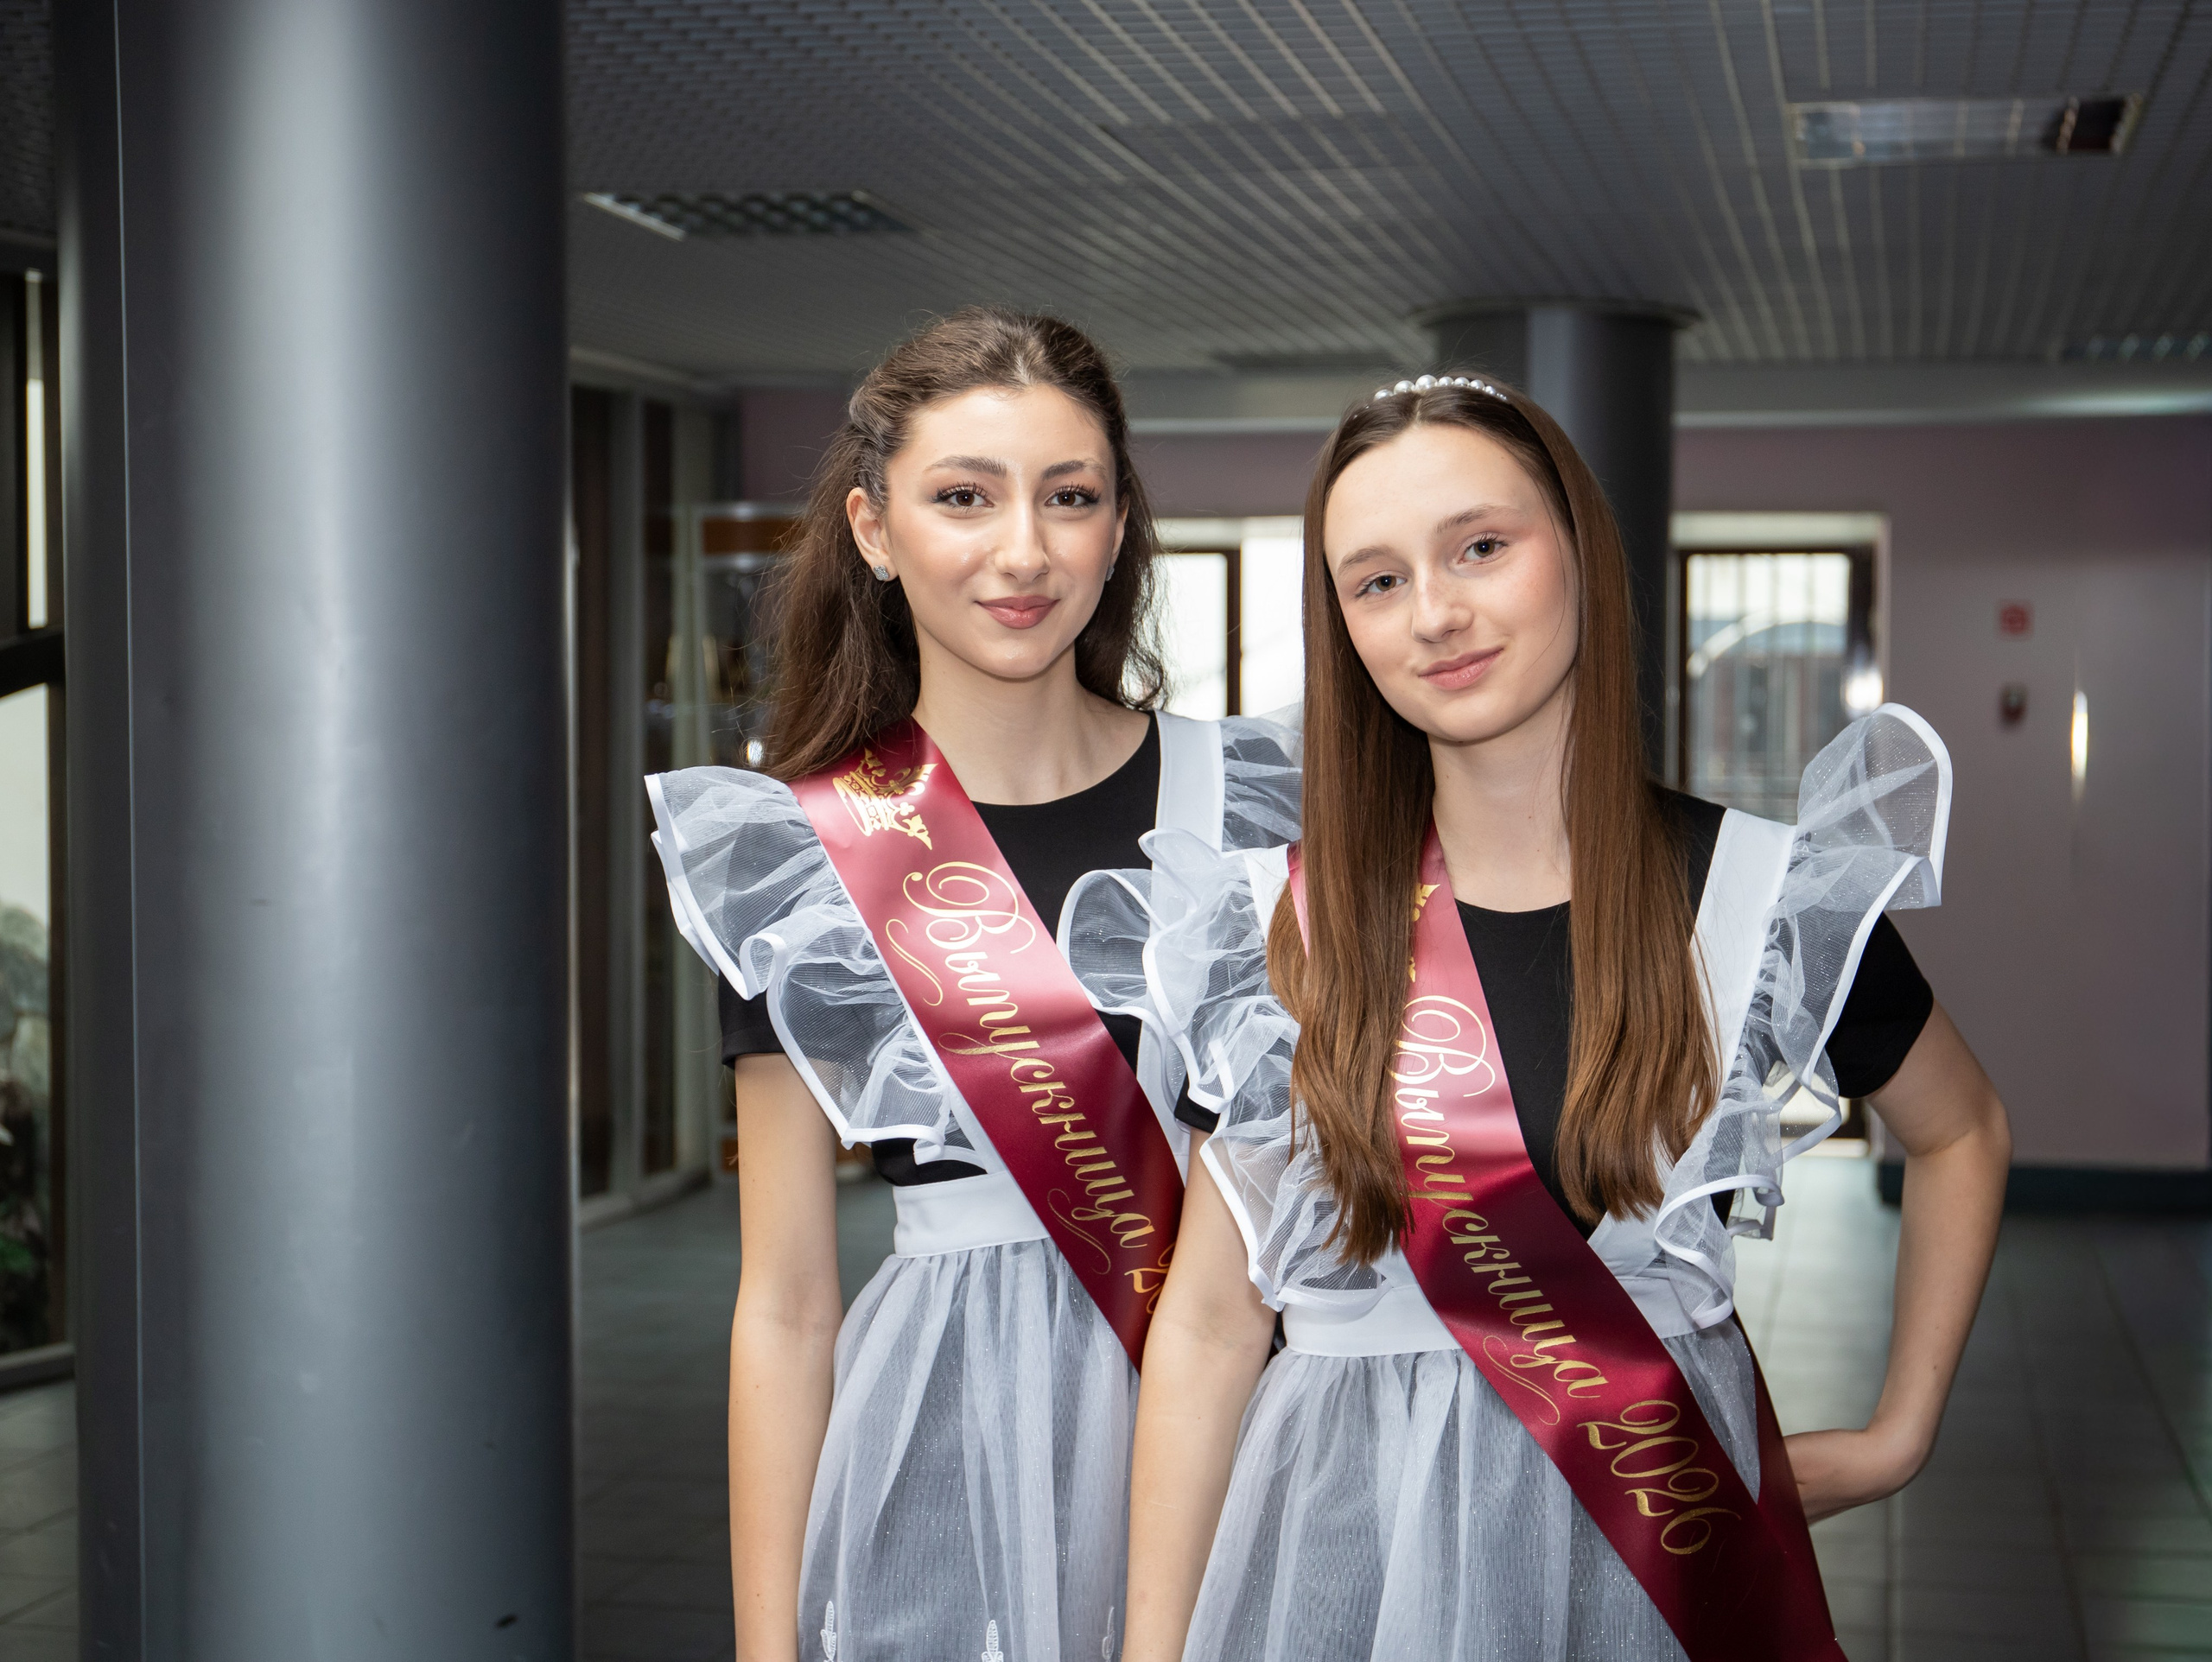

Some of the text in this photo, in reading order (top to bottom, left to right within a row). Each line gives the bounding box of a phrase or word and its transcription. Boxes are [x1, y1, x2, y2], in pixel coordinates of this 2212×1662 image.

[886, 860, 1156, 1275] Выпускница
[1388, 994, 1741, 1556] Выпускница 2026
